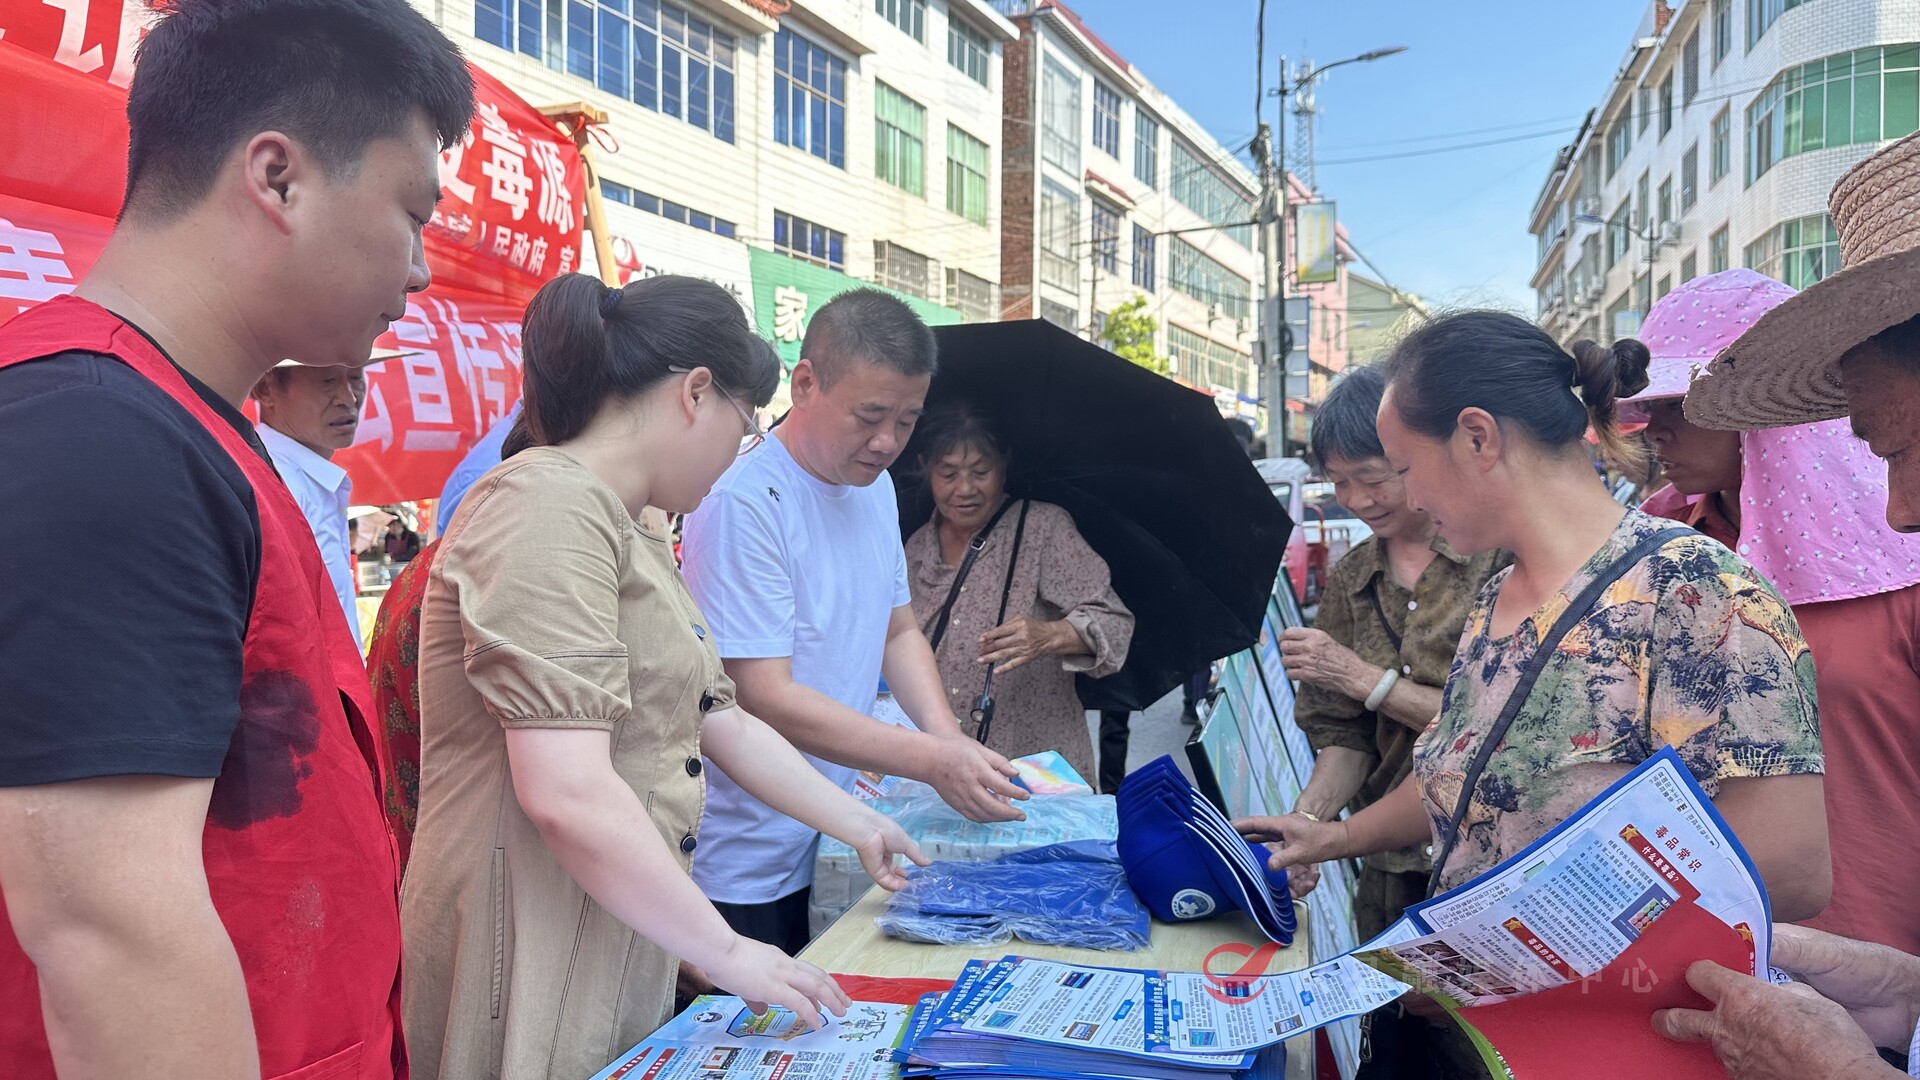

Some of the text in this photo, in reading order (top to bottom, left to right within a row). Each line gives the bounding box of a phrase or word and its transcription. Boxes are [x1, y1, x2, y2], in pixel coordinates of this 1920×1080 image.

[1652, 824, 1703, 873] 毒品常识
[1526, 935, 1562, 969] 毒品的危害
